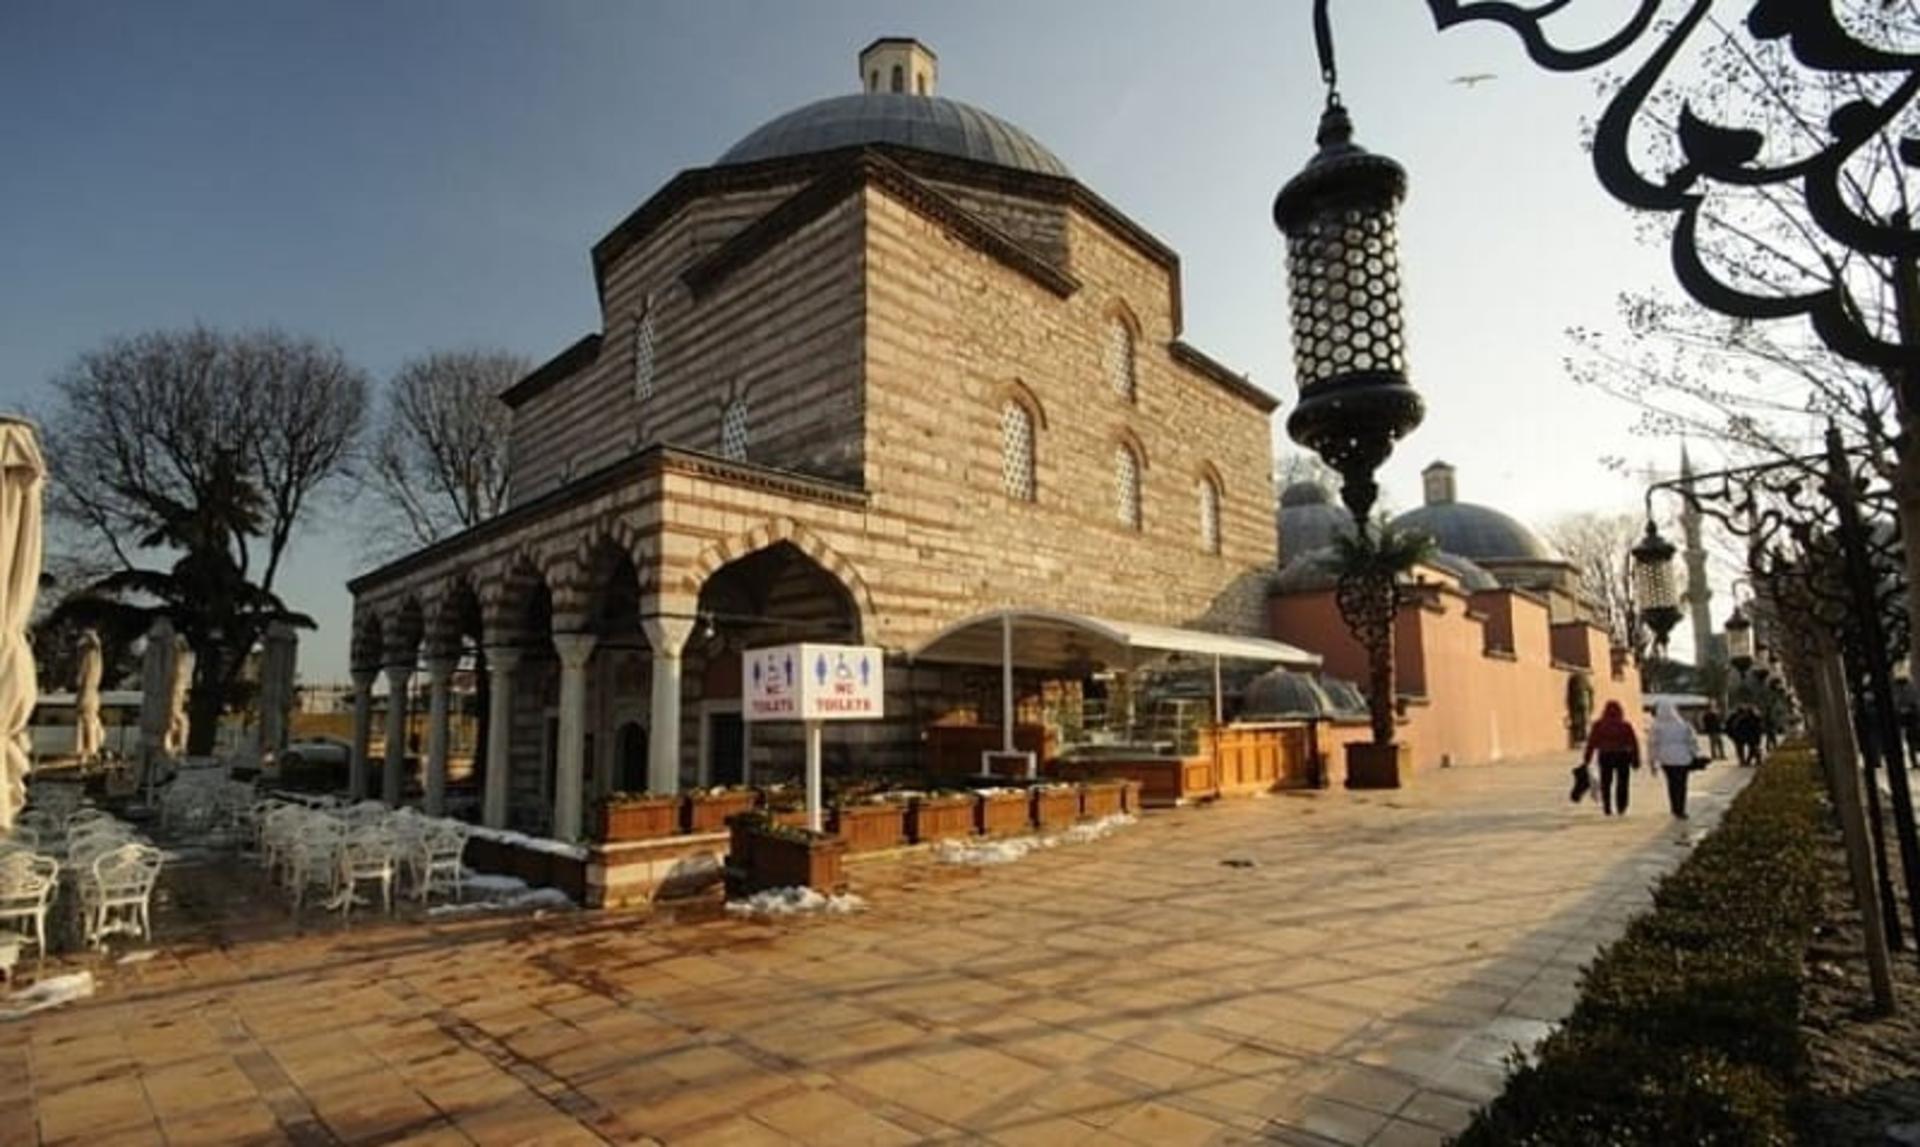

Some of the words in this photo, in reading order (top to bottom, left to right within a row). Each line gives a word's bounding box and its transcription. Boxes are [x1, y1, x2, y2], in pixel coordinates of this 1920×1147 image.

[765, 683, 784, 694] WC
[834, 683, 855, 694] WC
[752, 699, 794, 713] TOILETS
[816, 698, 872, 712] TOILETS
